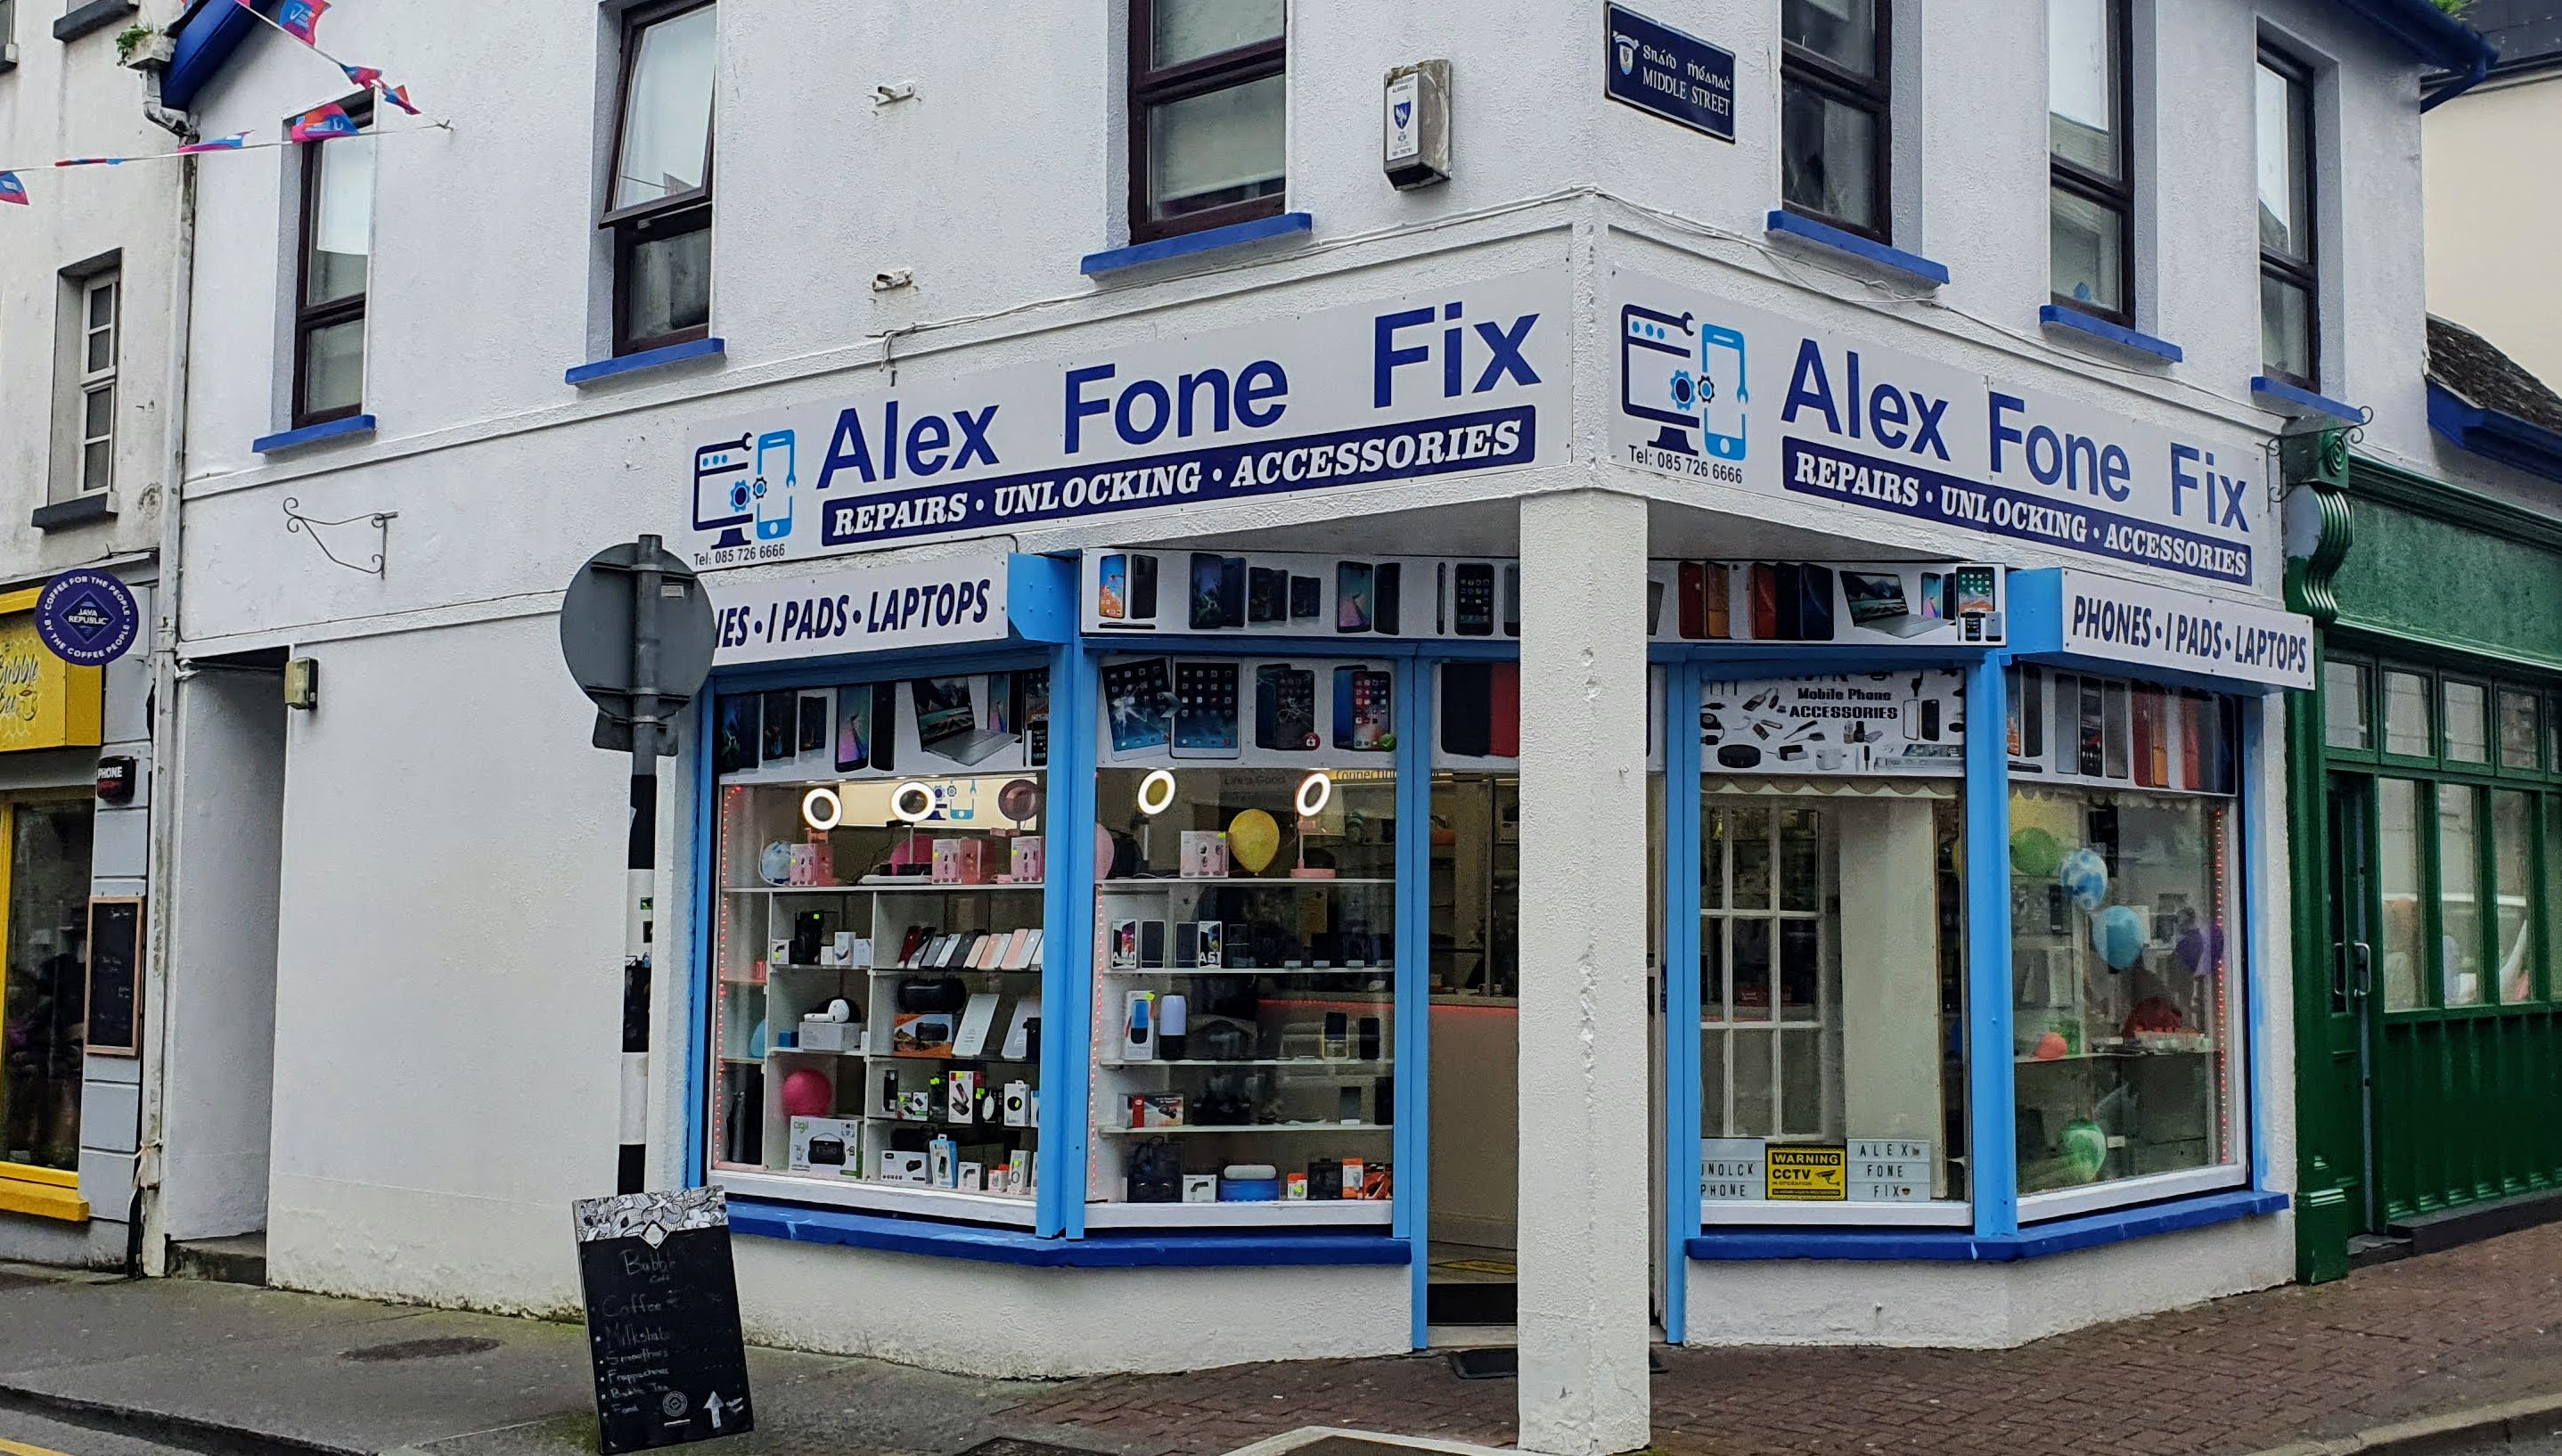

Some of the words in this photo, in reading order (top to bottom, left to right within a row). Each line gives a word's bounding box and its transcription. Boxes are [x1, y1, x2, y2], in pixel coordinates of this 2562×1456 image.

[1642, 66, 1687, 100] MIDDLE
[1691, 86, 1731, 117] STREET
[816, 401, 1000, 489] Alex
[1065, 359, 1289, 454] Fone
[1373, 301, 1542, 408] Fix
[1780, 338, 1952, 462] Alex
[1989, 391, 2131, 502] Fone
[2170, 442, 2250, 532] Fix
[1628, 444, 1653, 466] Tel:
[1658, 452, 1682, 471] 085
[1685, 457, 1708, 477] 726
[1713, 463, 1743, 484] 6666
[831, 493, 967, 536] REPAIRS
[994, 461, 1202, 517] UNLOCKING
[1230, 419, 1521, 488] ACCESSORIES
[1794, 451, 1919, 507] REPAIRS
[1941, 485, 2087, 544] UNLOCKING
[2104, 523, 2247, 577] ACCESSORIES
[693, 552, 712, 566] Tel:
[715, 549, 734, 563] 085
[738, 547, 757, 560] 726
[759, 544, 786, 559] 6666
[45, 581, 70, 610] COFFEE
[69, 576, 88, 585] FOR
[91, 577, 109, 588] THE
[109, 585, 131, 616] PEOPLE
[78, 609, 98, 617] JAVA
[782, 594, 849, 642] PADS
[866, 579, 990, 634] LAPTOPS
[68, 616, 109, 626] REPUBLIC
[44, 619, 54, 631] BY
[50, 633, 67, 650] THE
[67, 648, 105, 658] COFFEE
[105, 625, 131, 653] PEOPLE
[2073, 594, 2151, 648] PHONES
[2177, 613, 2222, 659] PADS
[2235, 625, 2306, 674] LAPTOPS
[1797, 688, 1844, 700] Mobile
[1847, 688, 1891, 701] Phone
[1788, 705, 1898, 719] ACCESSORIES
[98, 766, 123, 780] PHONE
[1774, 1154, 1838, 1165] WARNING
[1860, 1144, 1907, 1157] ALEX
[1772, 1169, 1811, 1180] CCTV
[1867, 1165, 1903, 1177] FONE
[1700, 1183, 1745, 1197] PHONE
[1873, 1184, 1899, 1198] FIX
